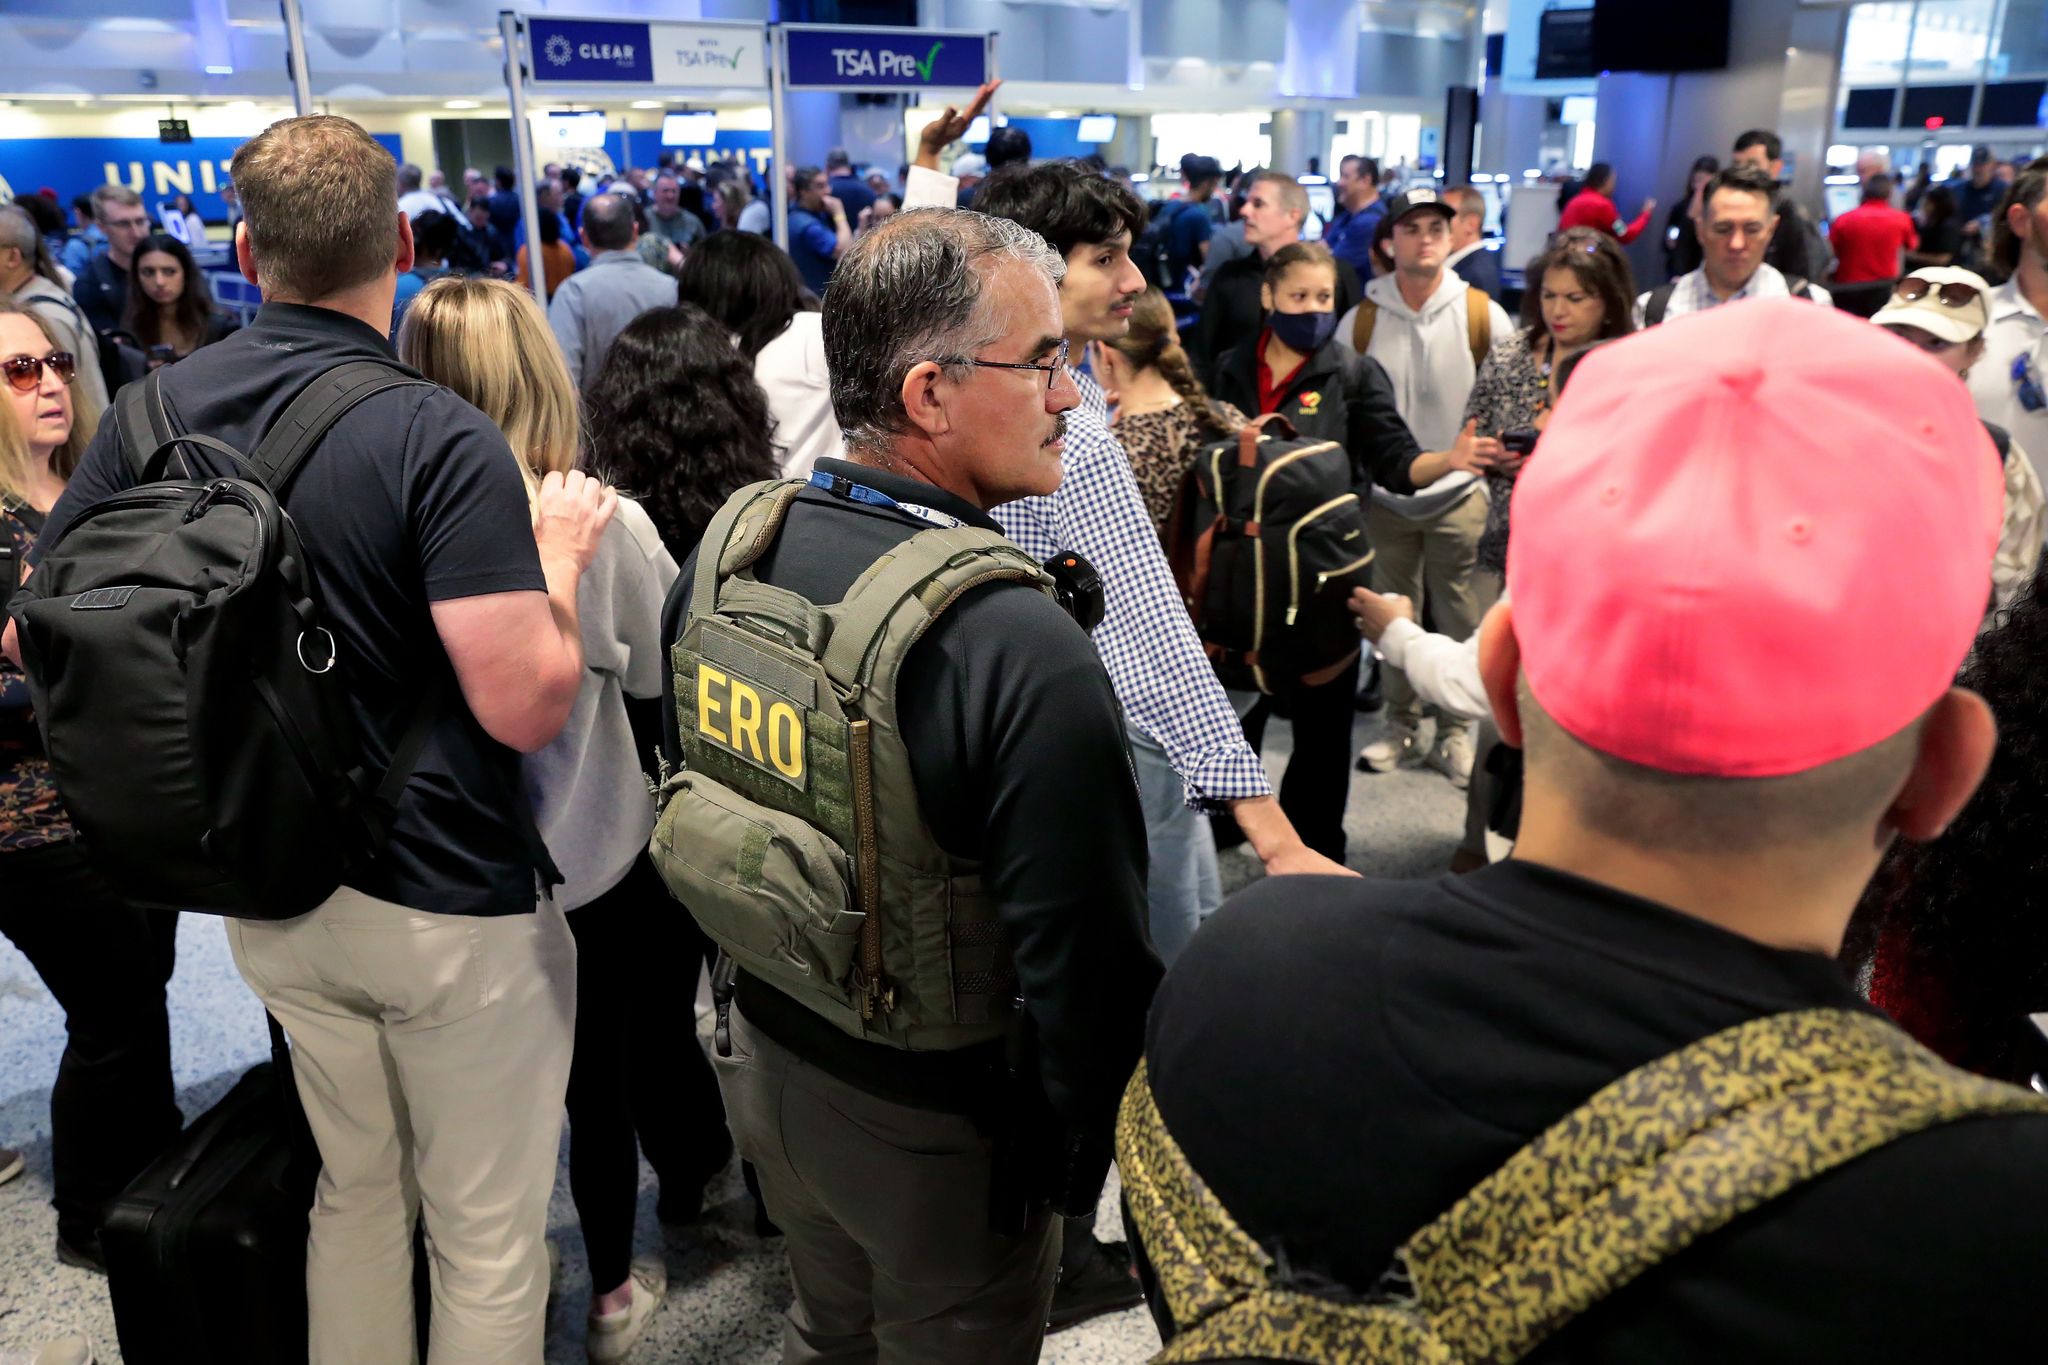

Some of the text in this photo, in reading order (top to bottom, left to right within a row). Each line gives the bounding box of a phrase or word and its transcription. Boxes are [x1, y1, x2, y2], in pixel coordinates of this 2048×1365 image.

[578, 44, 634, 59] CLEAR
[676, 50, 701, 67] TSA
[831, 49, 916, 77] TSA Pre
[103, 160, 231, 194] UNI
[698, 664, 802, 778] ERO
